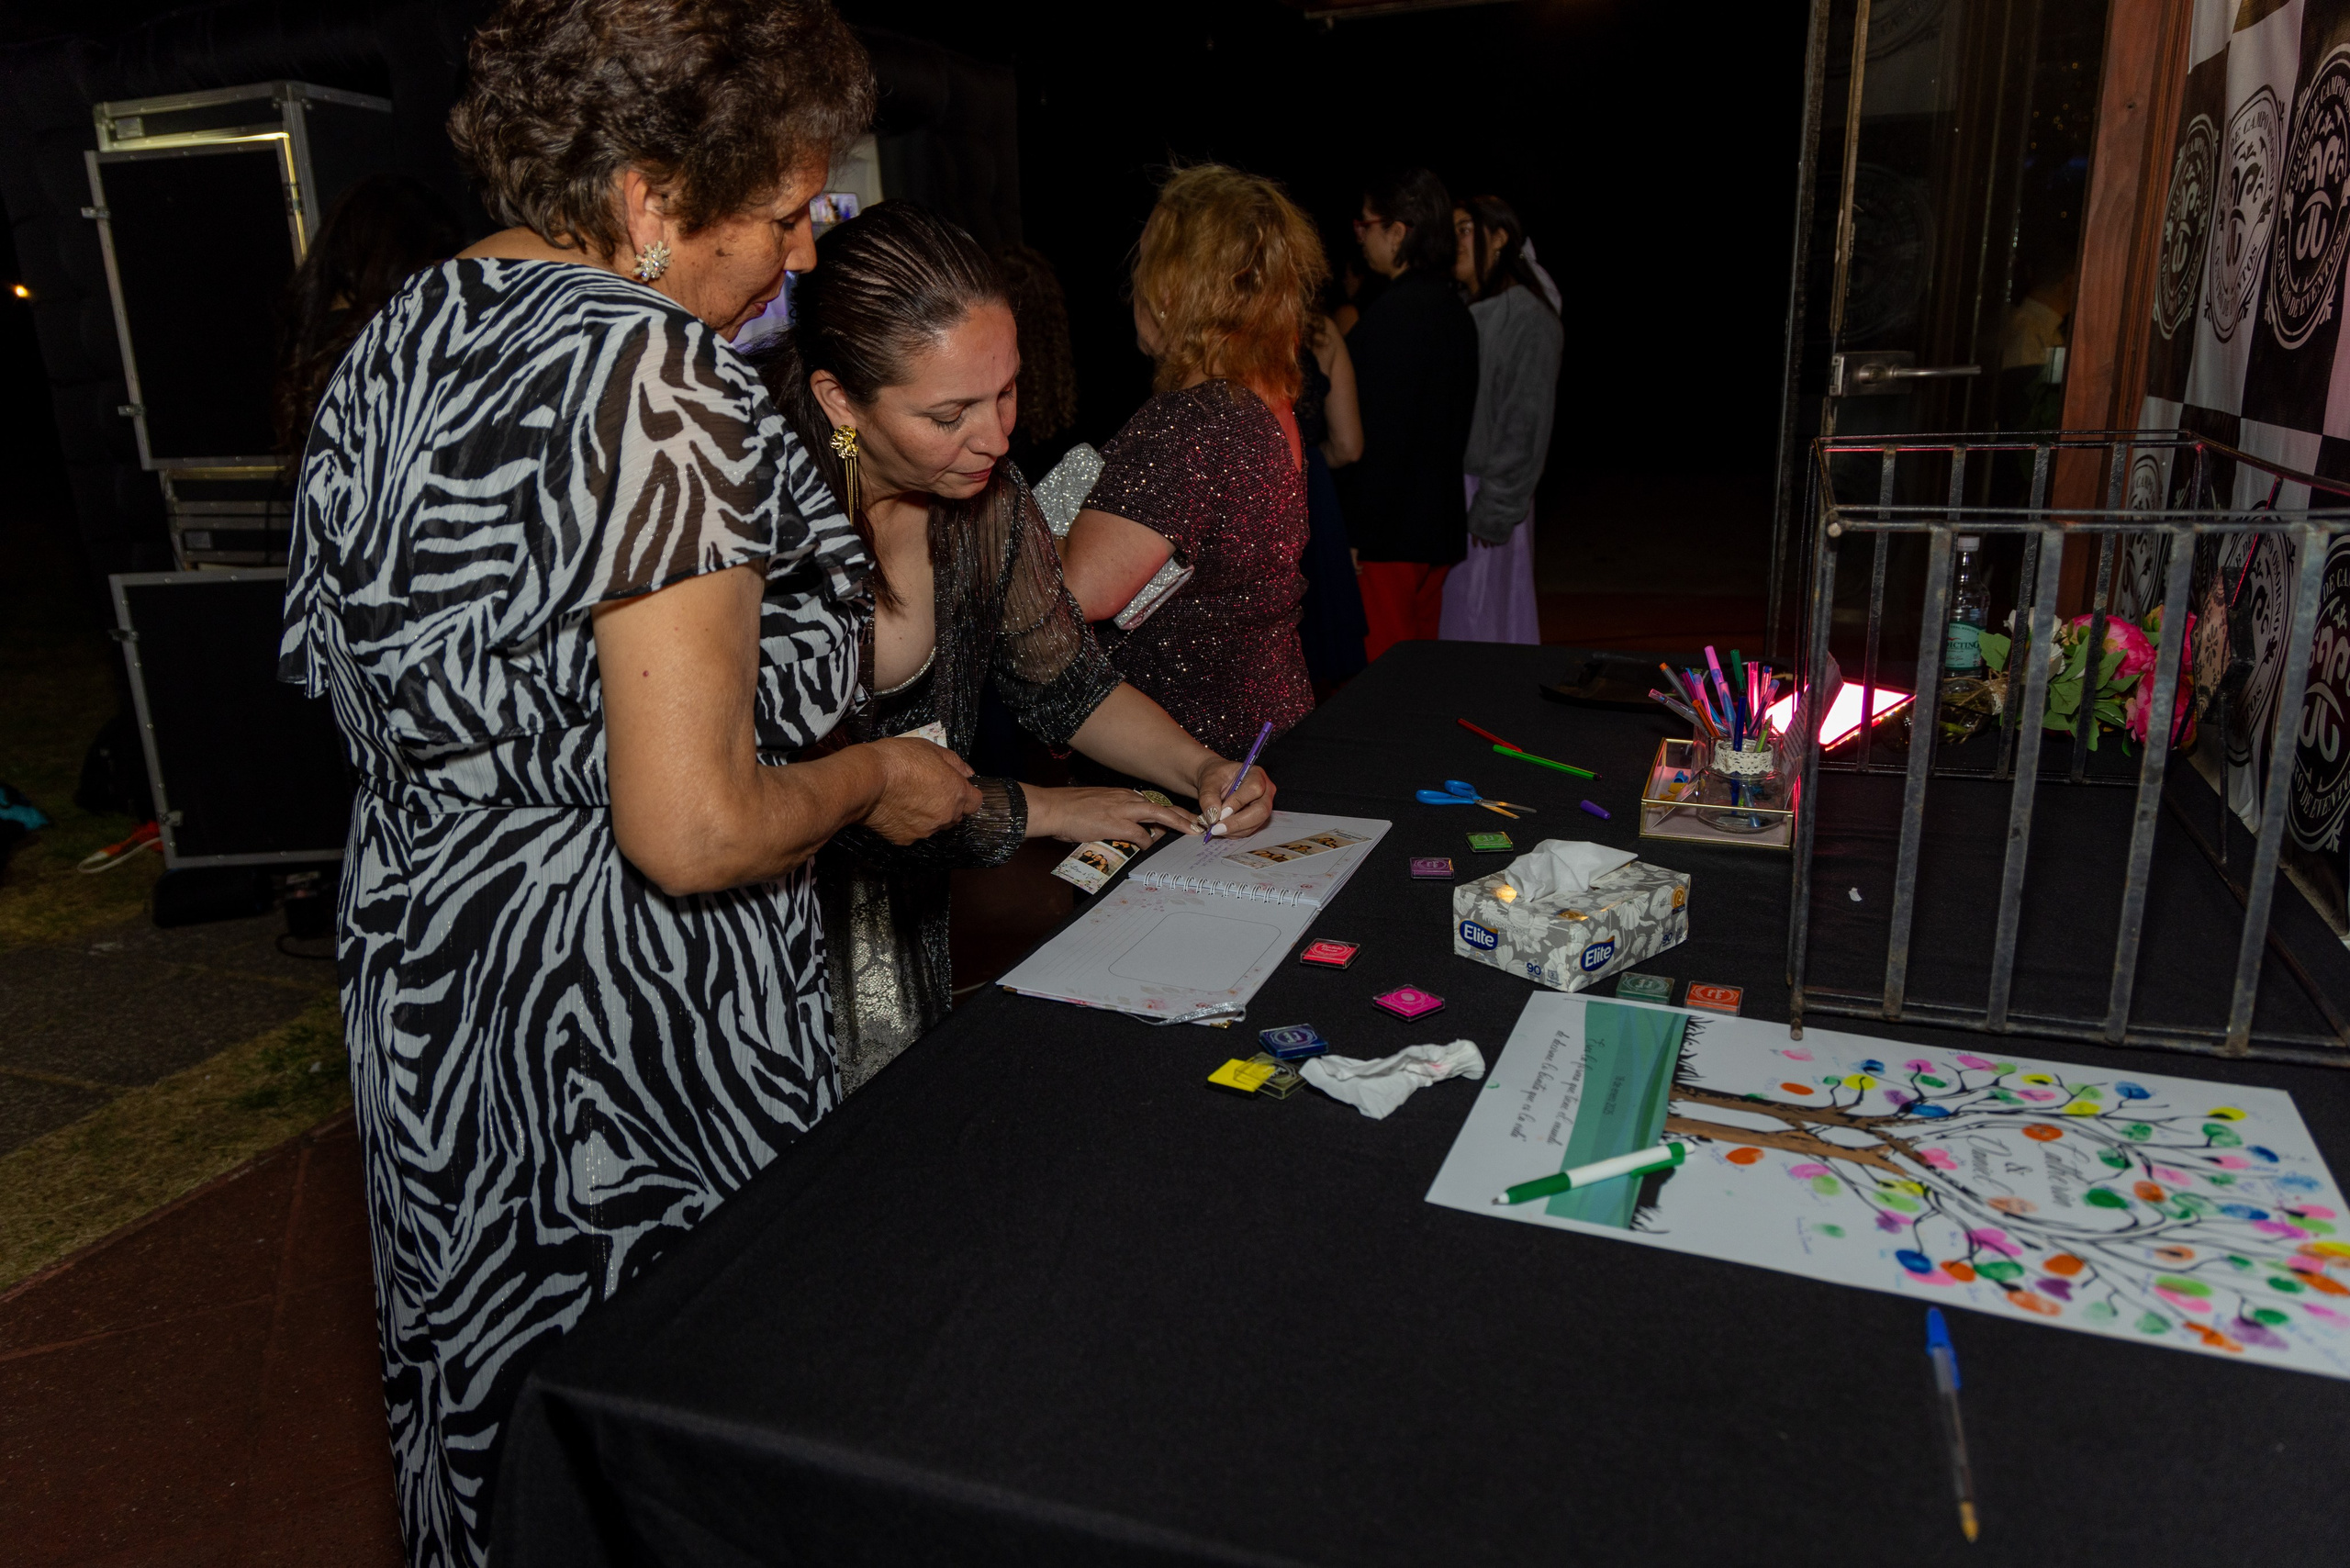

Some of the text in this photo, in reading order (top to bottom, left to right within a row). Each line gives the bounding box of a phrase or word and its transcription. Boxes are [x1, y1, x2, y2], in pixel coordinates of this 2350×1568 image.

[2320, 75, 2346, 104] CAMPO
[2243, 110, 2269, 136] CAMPO
[2322, 573, 2335, 603] DE
[2300, 785, 2313, 814] DE
[2309, 769, 2350, 819] EVENTO
[1463, 924, 1494, 947] Elite
[1662, 932, 1673, 945] 90
[1526, 962, 1542, 976] 90
[1584, 946, 1612, 969] Elite
[1520, 1090, 1537, 1103] que
[1561, 1081, 1578, 1094] que
[2004, 1161, 2033, 1176] &
